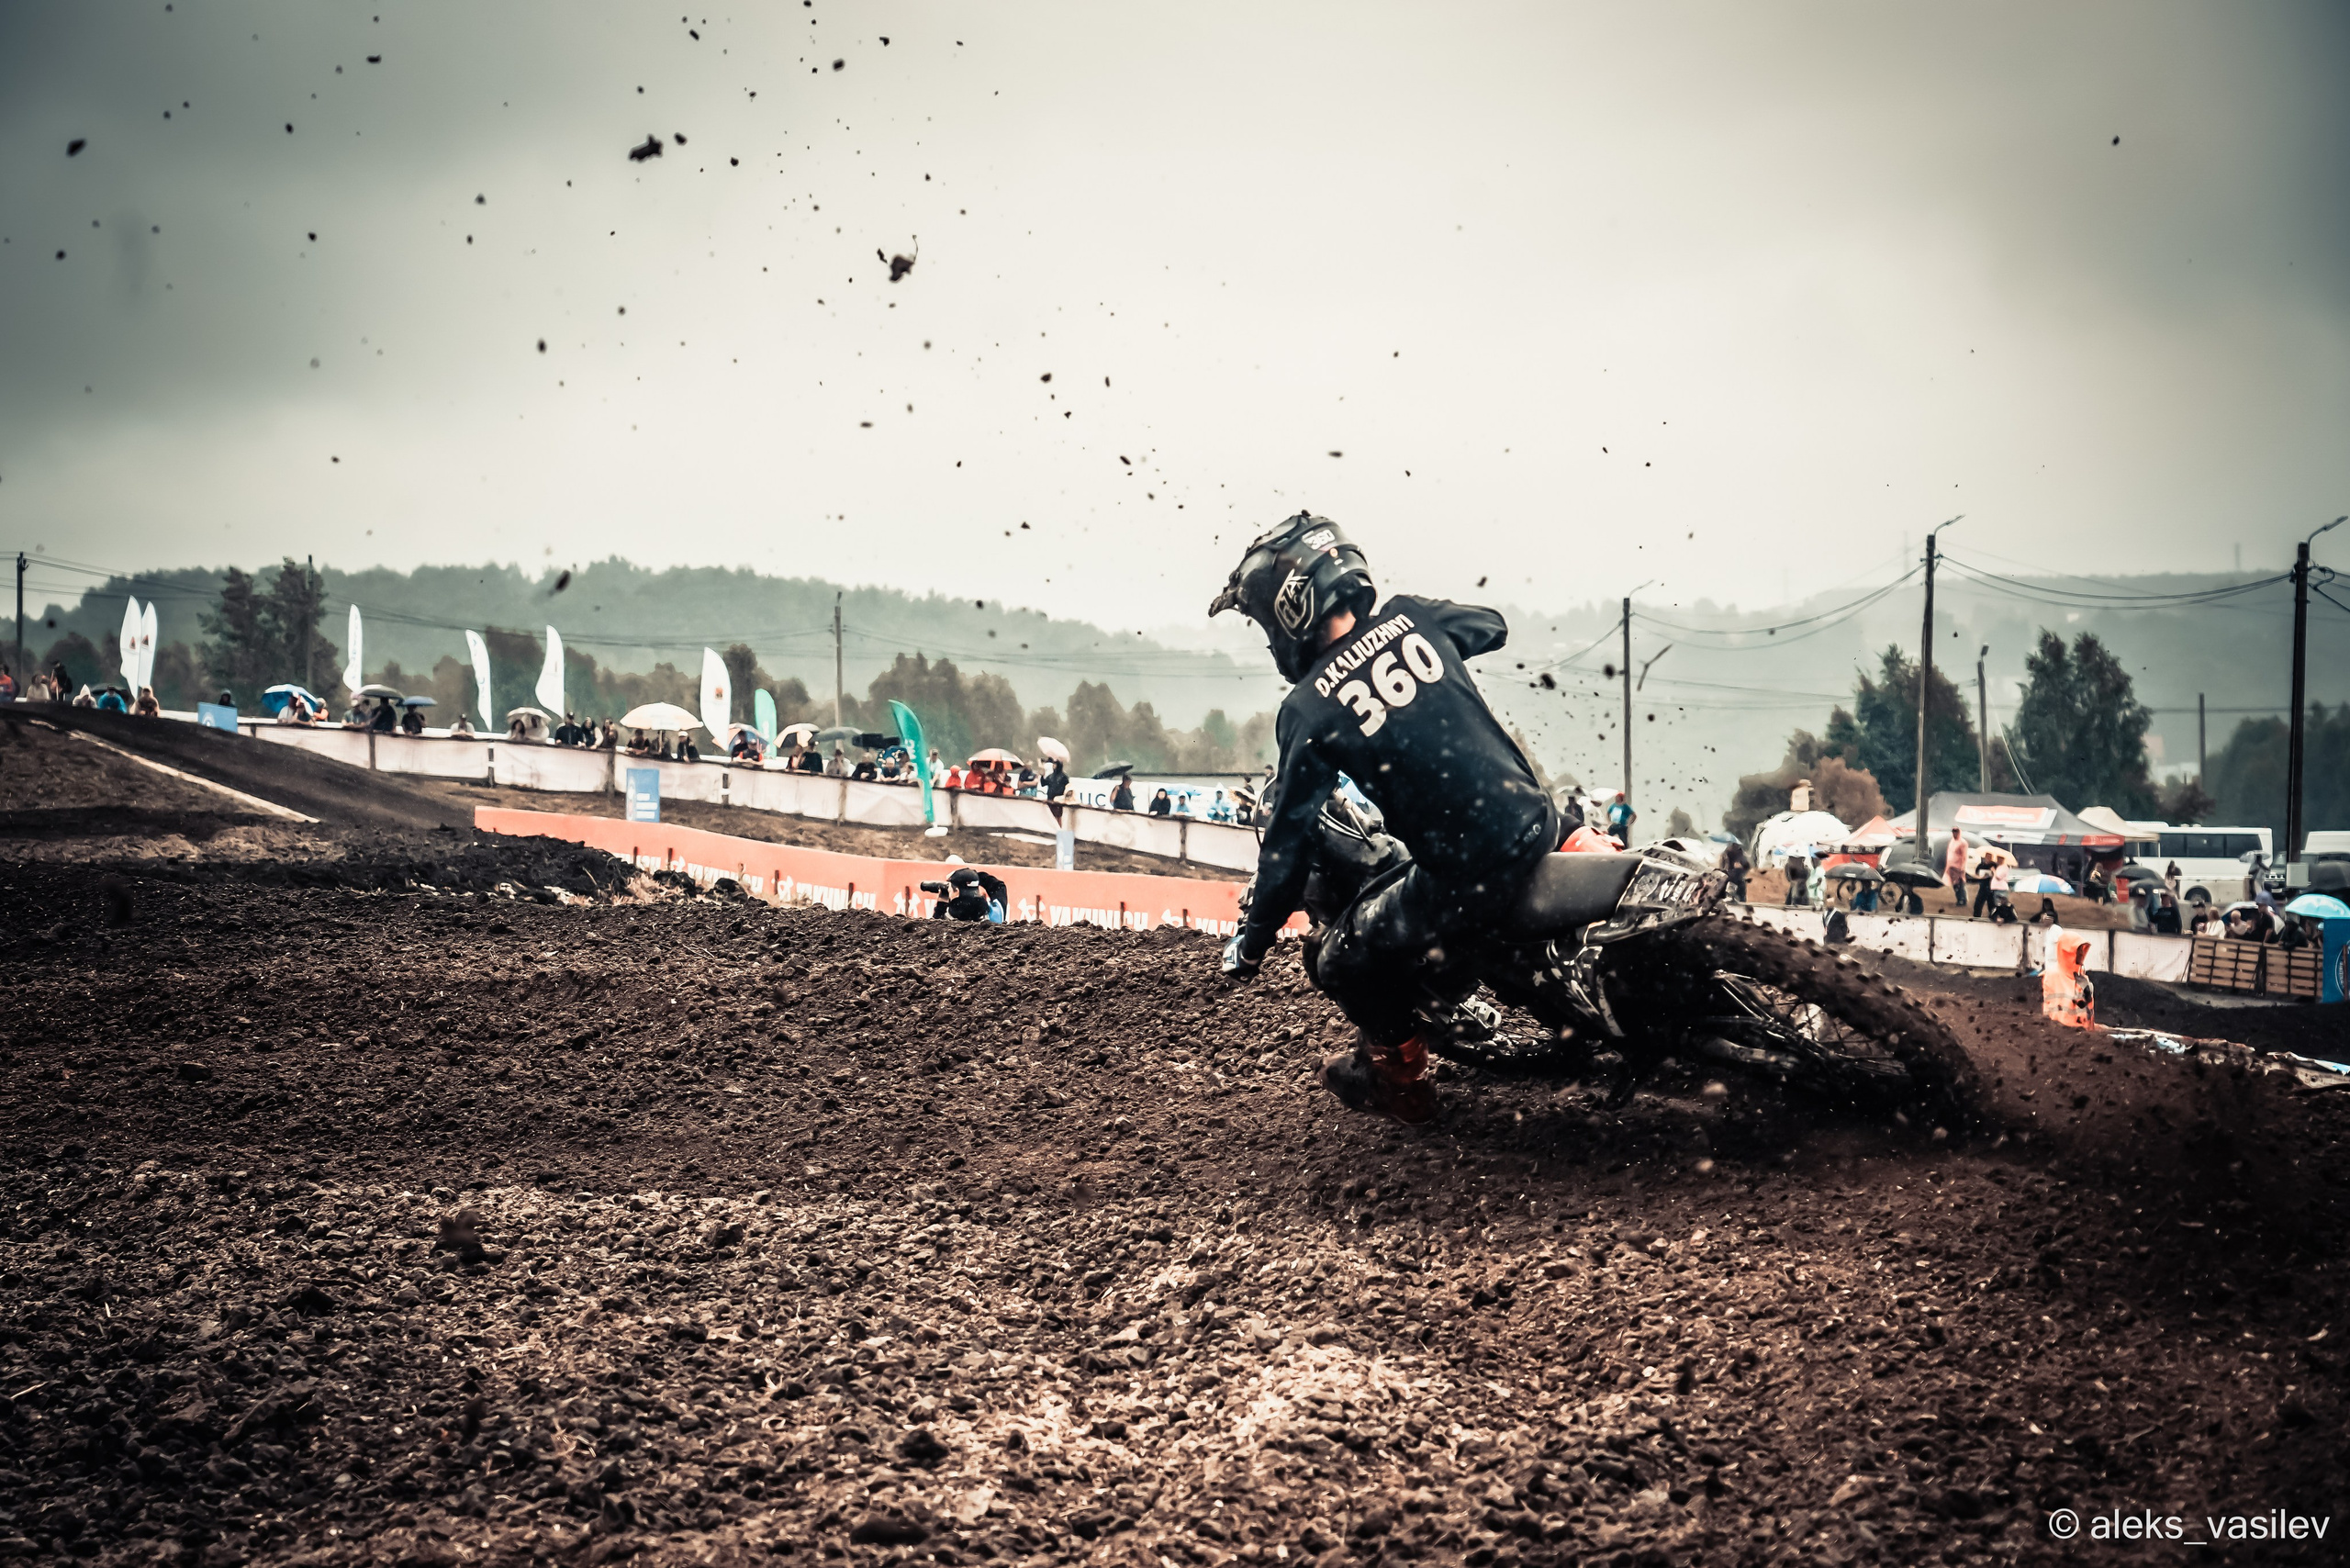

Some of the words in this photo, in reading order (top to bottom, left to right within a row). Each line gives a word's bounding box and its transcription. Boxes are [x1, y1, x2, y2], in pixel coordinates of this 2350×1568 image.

[1315, 613, 1415, 698] D.KALIUZHNYI
[1337, 633, 1445, 737] 360
[1049, 905, 1148, 932] YAKHNICH
